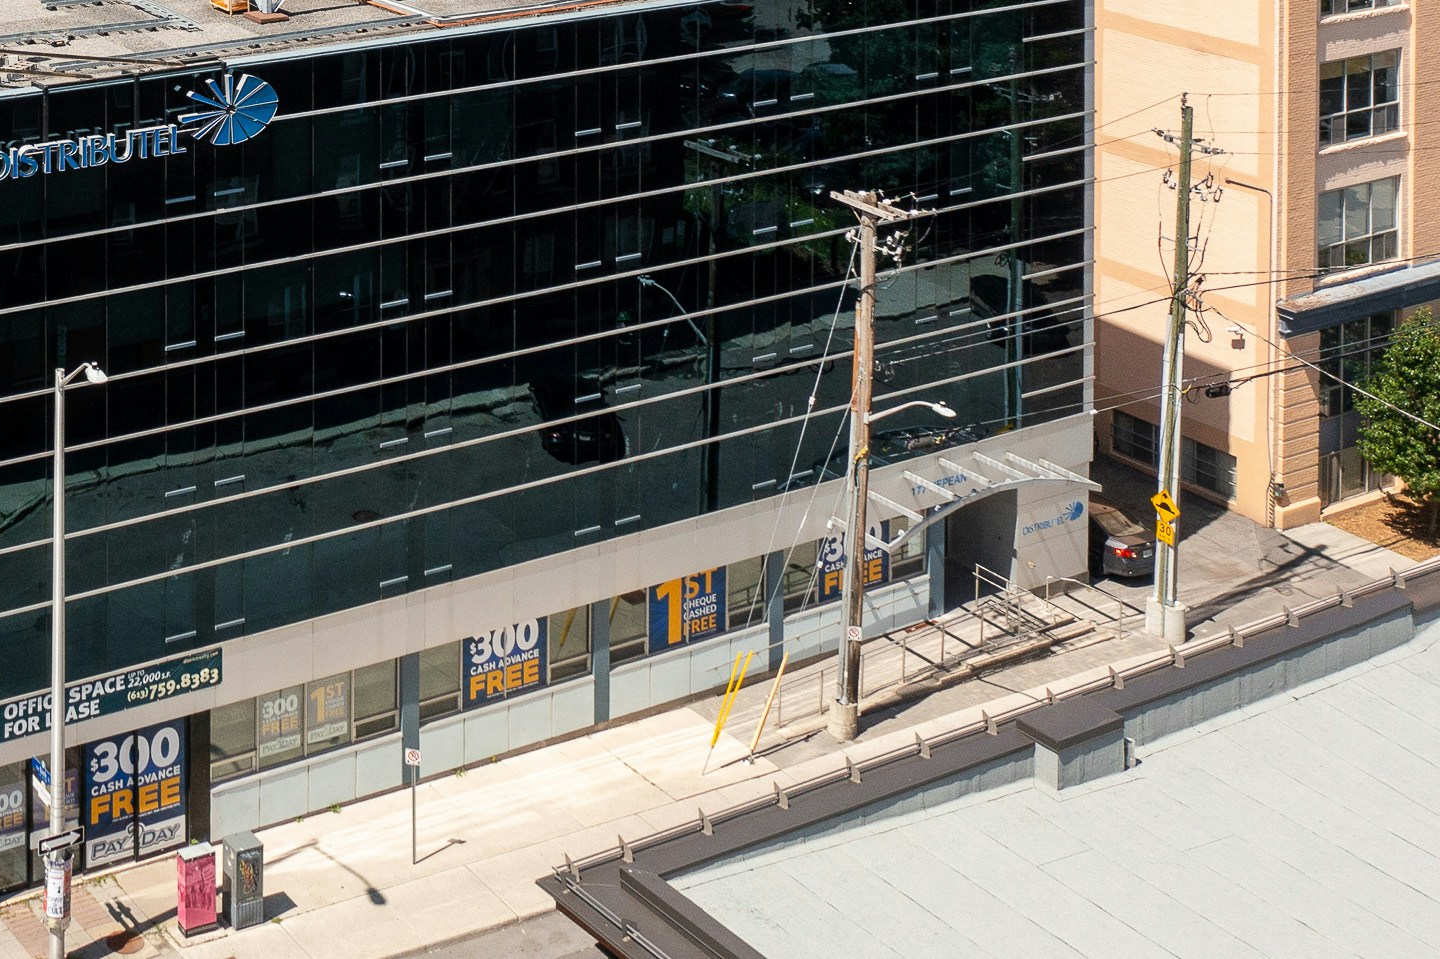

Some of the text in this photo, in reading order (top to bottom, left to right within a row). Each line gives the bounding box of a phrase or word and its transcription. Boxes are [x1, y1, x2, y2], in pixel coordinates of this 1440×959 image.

[933, 474, 968, 488] EPEAN
[1159, 523, 1172, 536] 30
[656, 566, 718, 645] 1ST
[683, 594, 717, 611] CHEQUE
[683, 603, 717, 621] CASHED
[469, 617, 540, 665] $300
[469, 657, 539, 700] FREE
[470, 648, 540, 676] CASH ADVANCE
[4, 674, 126, 721] OFFIC SPACE
[127, 671, 161, 689] 22,000
[127, 667, 219, 702] (613) 759.8383
[4, 699, 100, 739] FOR LASE
[310, 681, 345, 724] 1ST
[262, 716, 298, 736] FREE
[90, 727, 180, 783] $300
[91, 779, 124, 797] CASH
[126, 764, 181, 787] ADVANCE
[90, 776, 181, 825] FREE
